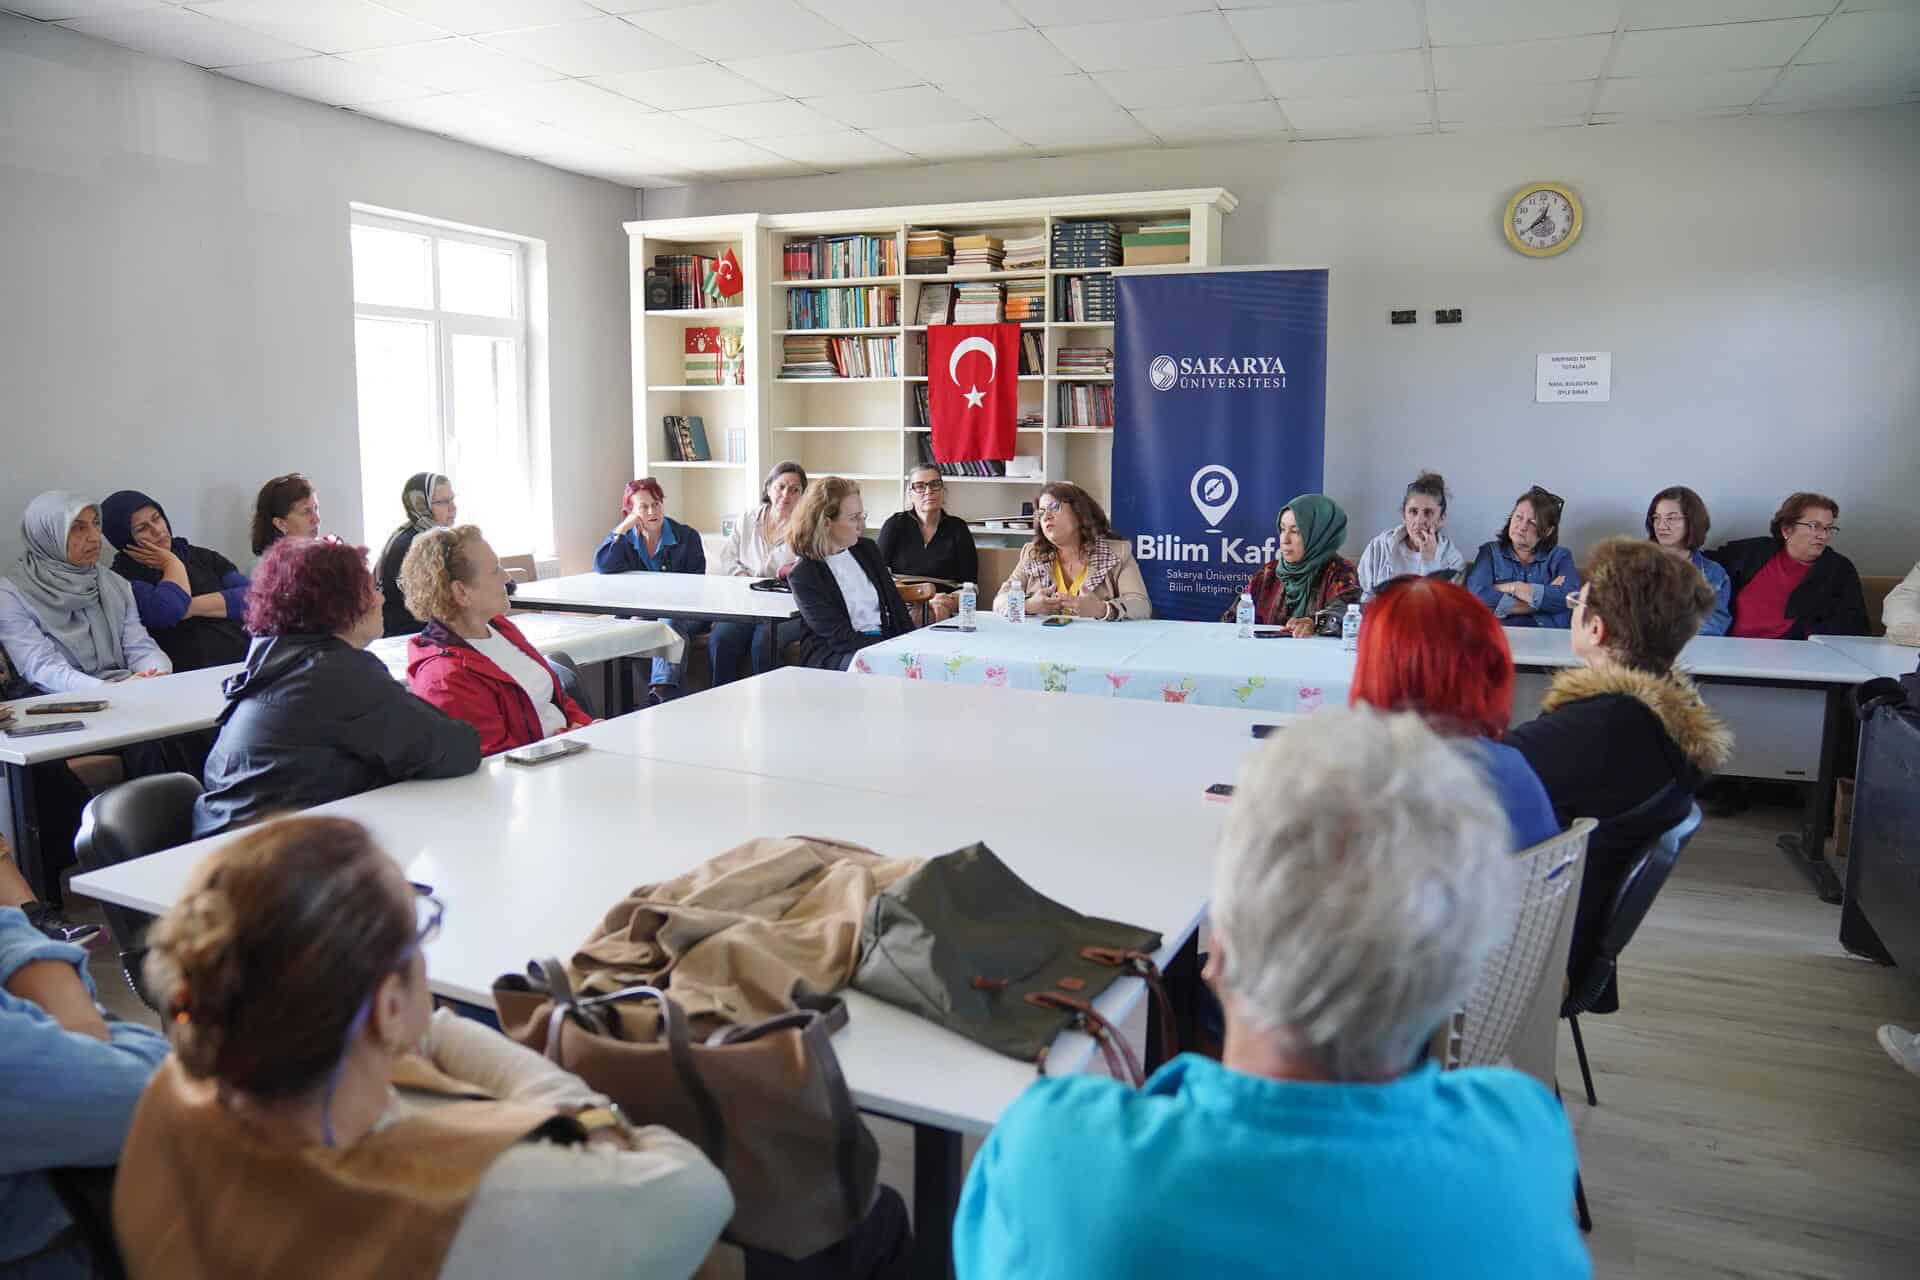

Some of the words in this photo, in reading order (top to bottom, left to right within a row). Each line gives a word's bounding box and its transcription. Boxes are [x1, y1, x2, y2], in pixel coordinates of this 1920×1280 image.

[1180, 357, 1286, 375] SAKARYA
[1180, 376, 1286, 389] ÜNİVERSİTESİ
[1136, 534, 1209, 562] Bilim
[1166, 568, 1203, 581] Sakarya
[1205, 569, 1253, 582] Üniversite
[1169, 582, 1193, 593] Bilim
